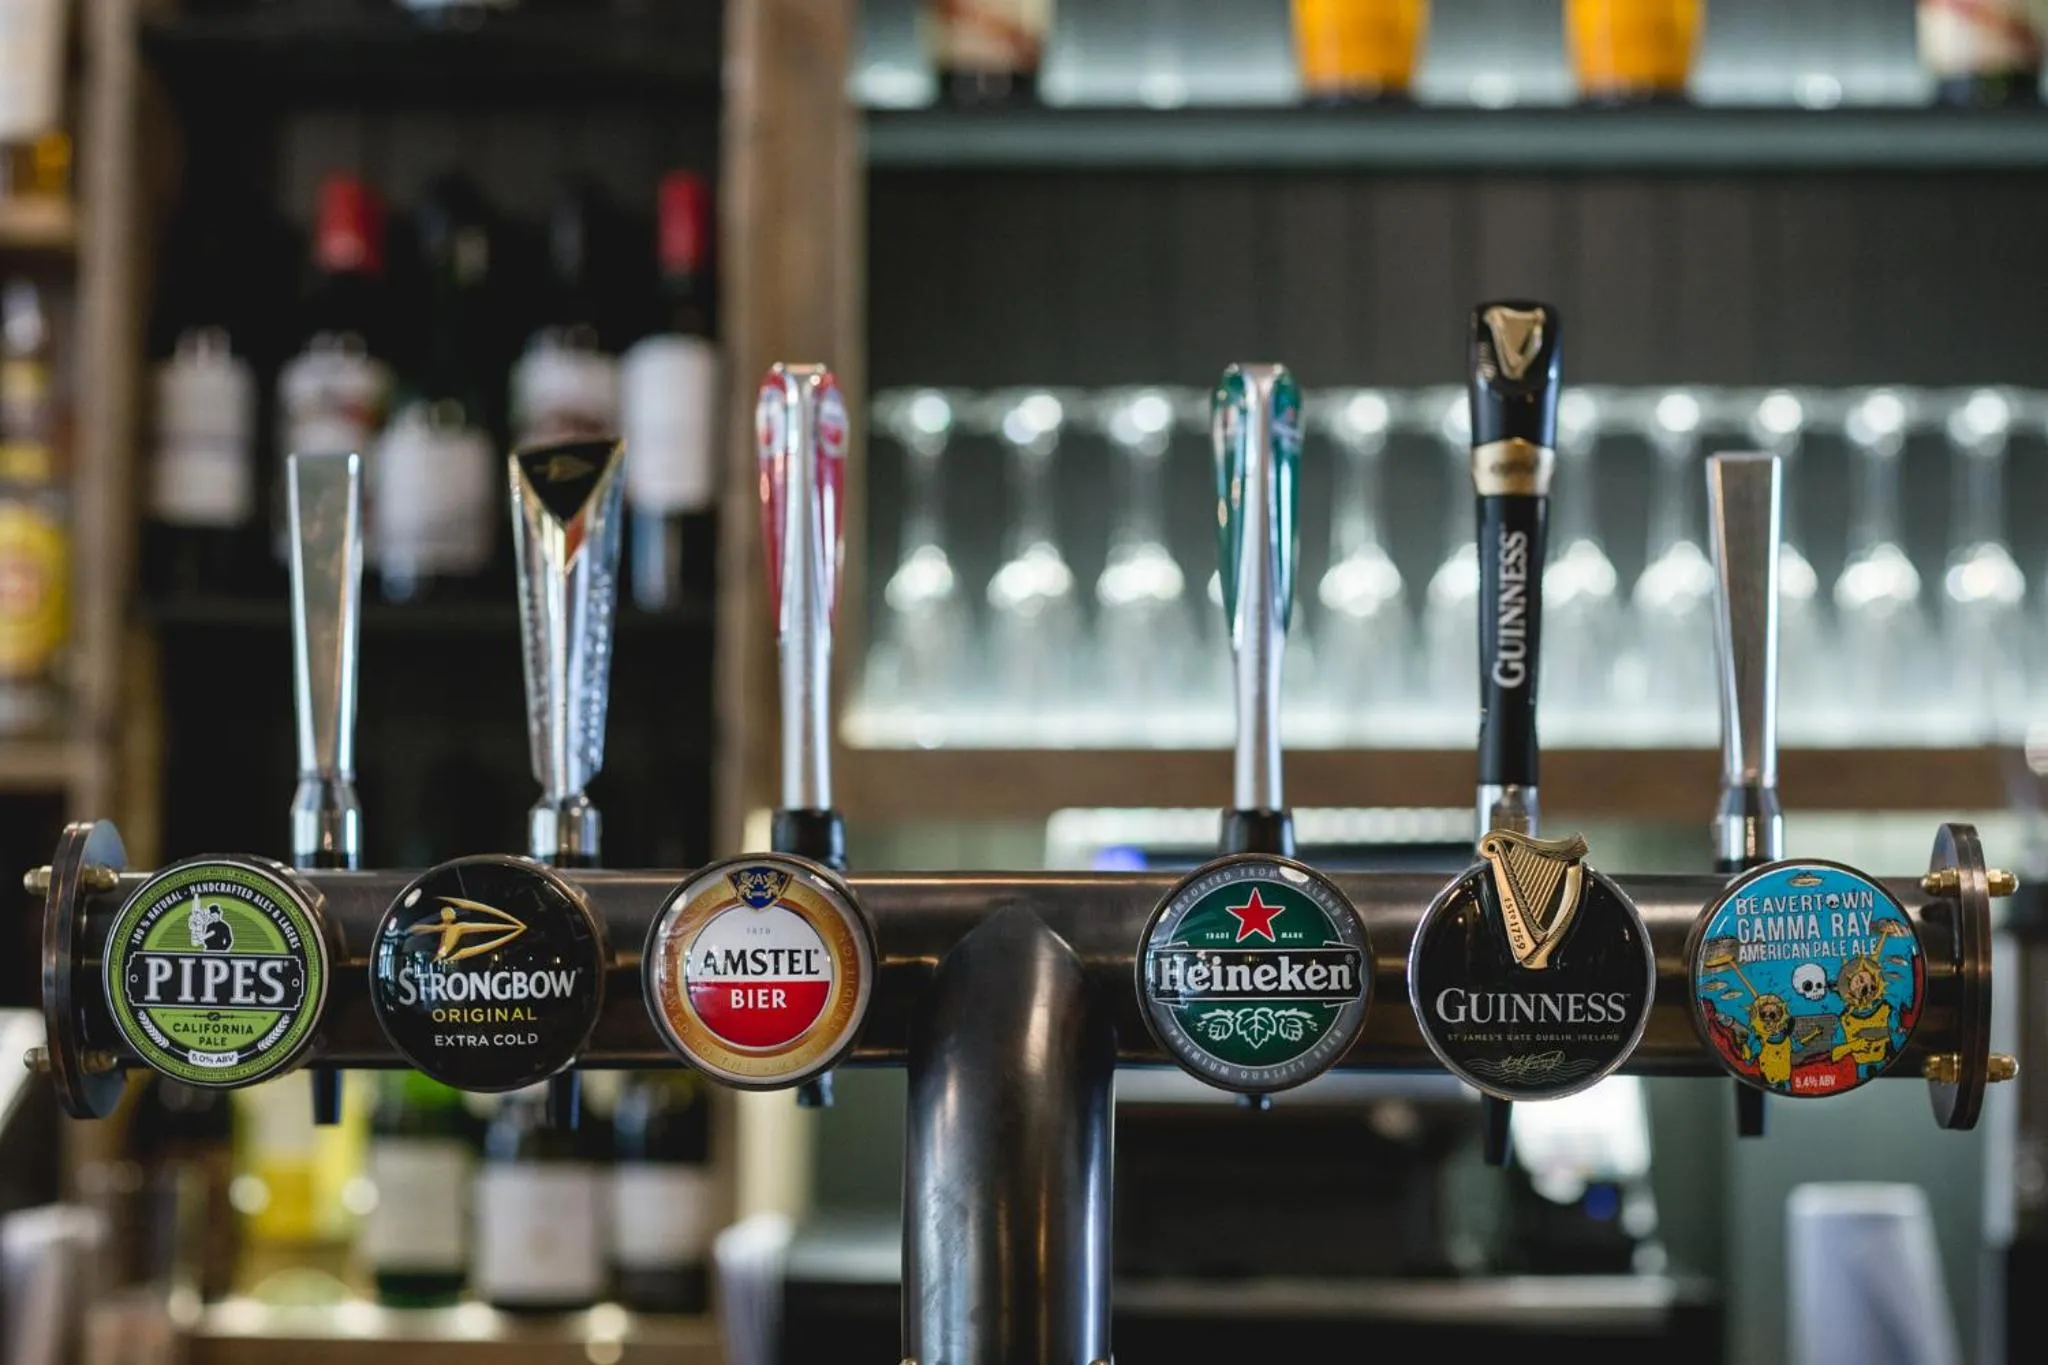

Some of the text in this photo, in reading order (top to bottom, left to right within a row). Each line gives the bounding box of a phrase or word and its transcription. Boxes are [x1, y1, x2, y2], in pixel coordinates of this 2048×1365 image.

[1492, 530, 1528, 689] GUINNESS
[131, 926, 145, 945] 100
[147, 890, 183, 922] NATURAL
[190, 881, 253, 901] HANDCRAFTED
[253, 893, 275, 913] ALES
[277, 915, 301, 949] LAGERS
[1735, 891, 1874, 915] BEAVERTOWN
[1205, 931, 1231, 940] TRADE
[1510, 921, 1526, 950] 1759
[1737, 911, 1874, 943] GAMMA RAY
[699, 948, 820, 976] AMSTEL
[1738, 937, 1878, 963] AMERICAN PALE ALE
[144, 957, 286, 1005] PIPES
[398, 966, 577, 1005] STRONGBOW
[1159, 955, 1353, 992] Heineken
[730, 988, 787, 1009] BIER
[1435, 988, 1627, 1023] GUINNESS
[172, 1022, 254, 1035] CALIFORNIA
[432, 1007, 539, 1023] ORIGINAL
[198, 1036, 228, 1047] PALE
[434, 1032, 539, 1047] EXTRA COLD
[215, 1055, 235, 1064] ABV
